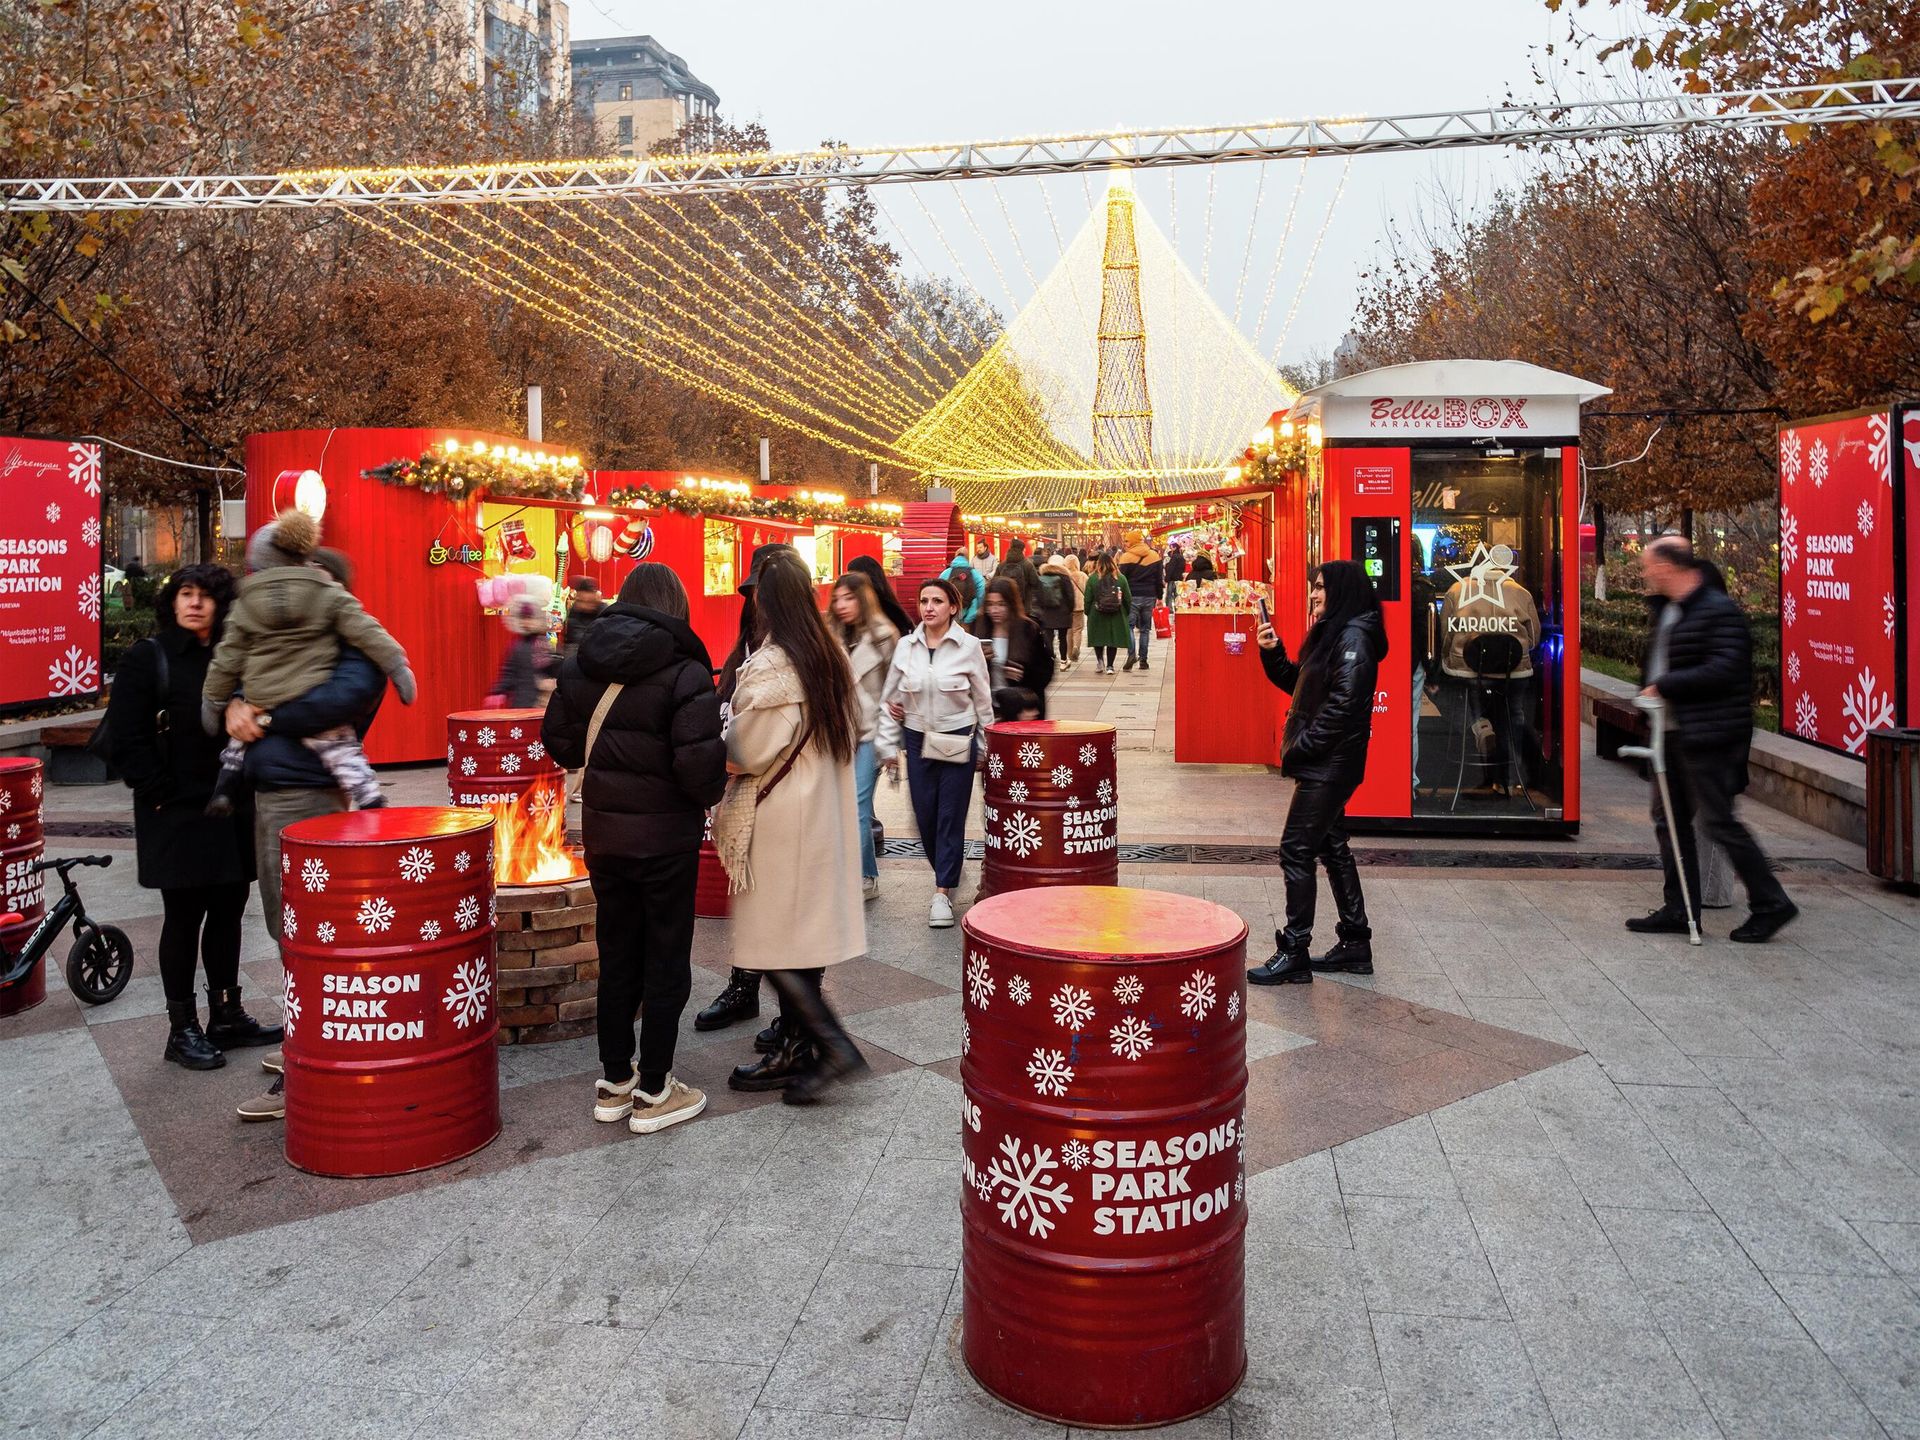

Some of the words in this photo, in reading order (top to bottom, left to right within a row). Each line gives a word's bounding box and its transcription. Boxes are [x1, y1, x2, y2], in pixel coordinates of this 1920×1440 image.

[1370, 397, 1442, 420] Bellis
[1443, 397, 1529, 429] BOX
[1370, 420, 1442, 428] KARAOKE
[0, 538, 68, 555] SEASONS
[447, 544, 482, 563] Coffee
[1806, 534, 1854, 554] SEASONS
[0, 558, 41, 574] PARK
[1806, 558, 1834, 577] PARK
[0, 576, 62, 593] STATION
[1806, 579, 1850, 601] STATION
[1448, 616, 1518, 632] KARAOKE
[460, 792, 519, 805] SEASONS
[1062, 804, 1117, 826] SEASONS
[1063, 823, 1104, 839] PARK
[1063, 834, 1117, 855] STATION
[6, 870, 42, 895] PARK
[323, 973, 421, 995] SEASON
[323, 997, 388, 1018] PARK
[322, 1019, 424, 1042] STATION
[1092, 1118, 1236, 1169] SEASONS
[1092, 1165, 1191, 1201] PARK
[1093, 1182, 1230, 1235] STATION
